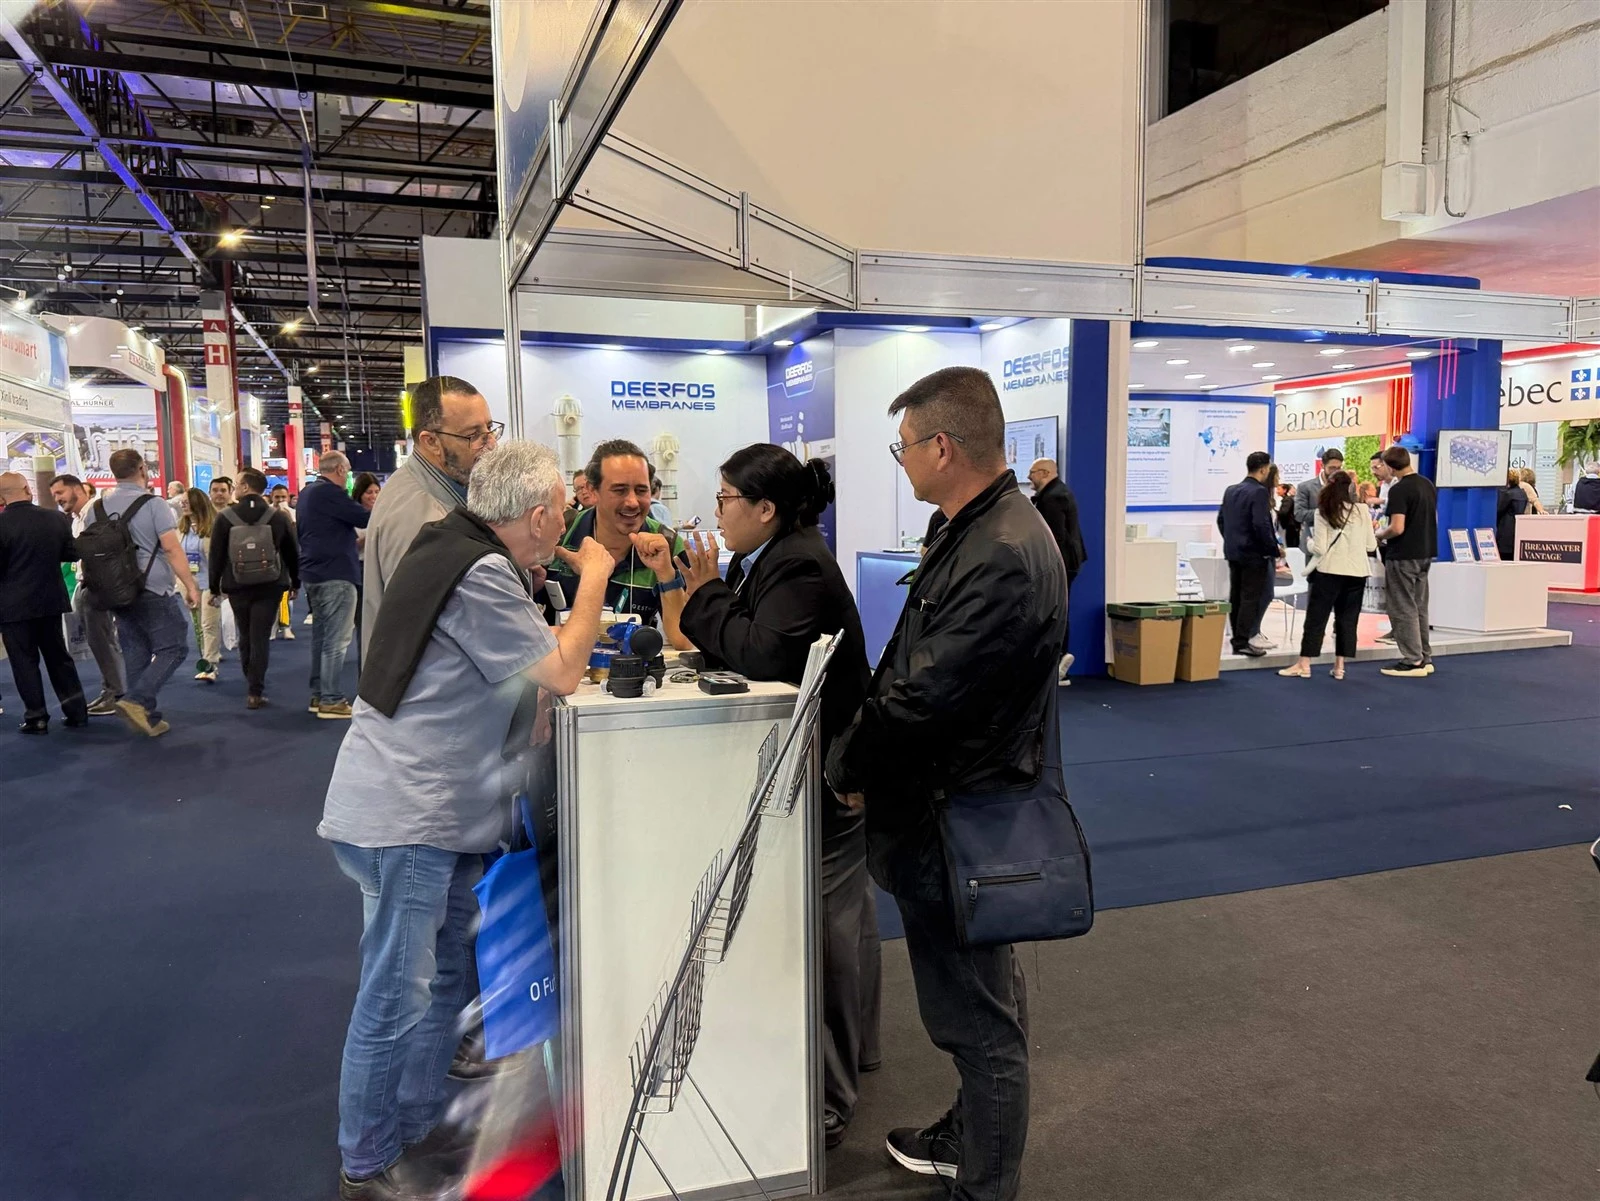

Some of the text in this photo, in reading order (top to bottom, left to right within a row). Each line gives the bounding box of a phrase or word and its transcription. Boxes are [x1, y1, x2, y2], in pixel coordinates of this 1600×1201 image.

[208, 346, 225, 363] H
[1003, 347, 1069, 378] DEERFOS
[1003, 369, 1069, 391] MEMBRANES
[610, 380, 716, 398] DEERFOS
[611, 399, 716, 411] MEMBRANES
[1275, 397, 1362, 434] Canada
[1524, 542, 1581, 553] BREAKWATER
[1524, 551, 1562, 561] VANTAGE
